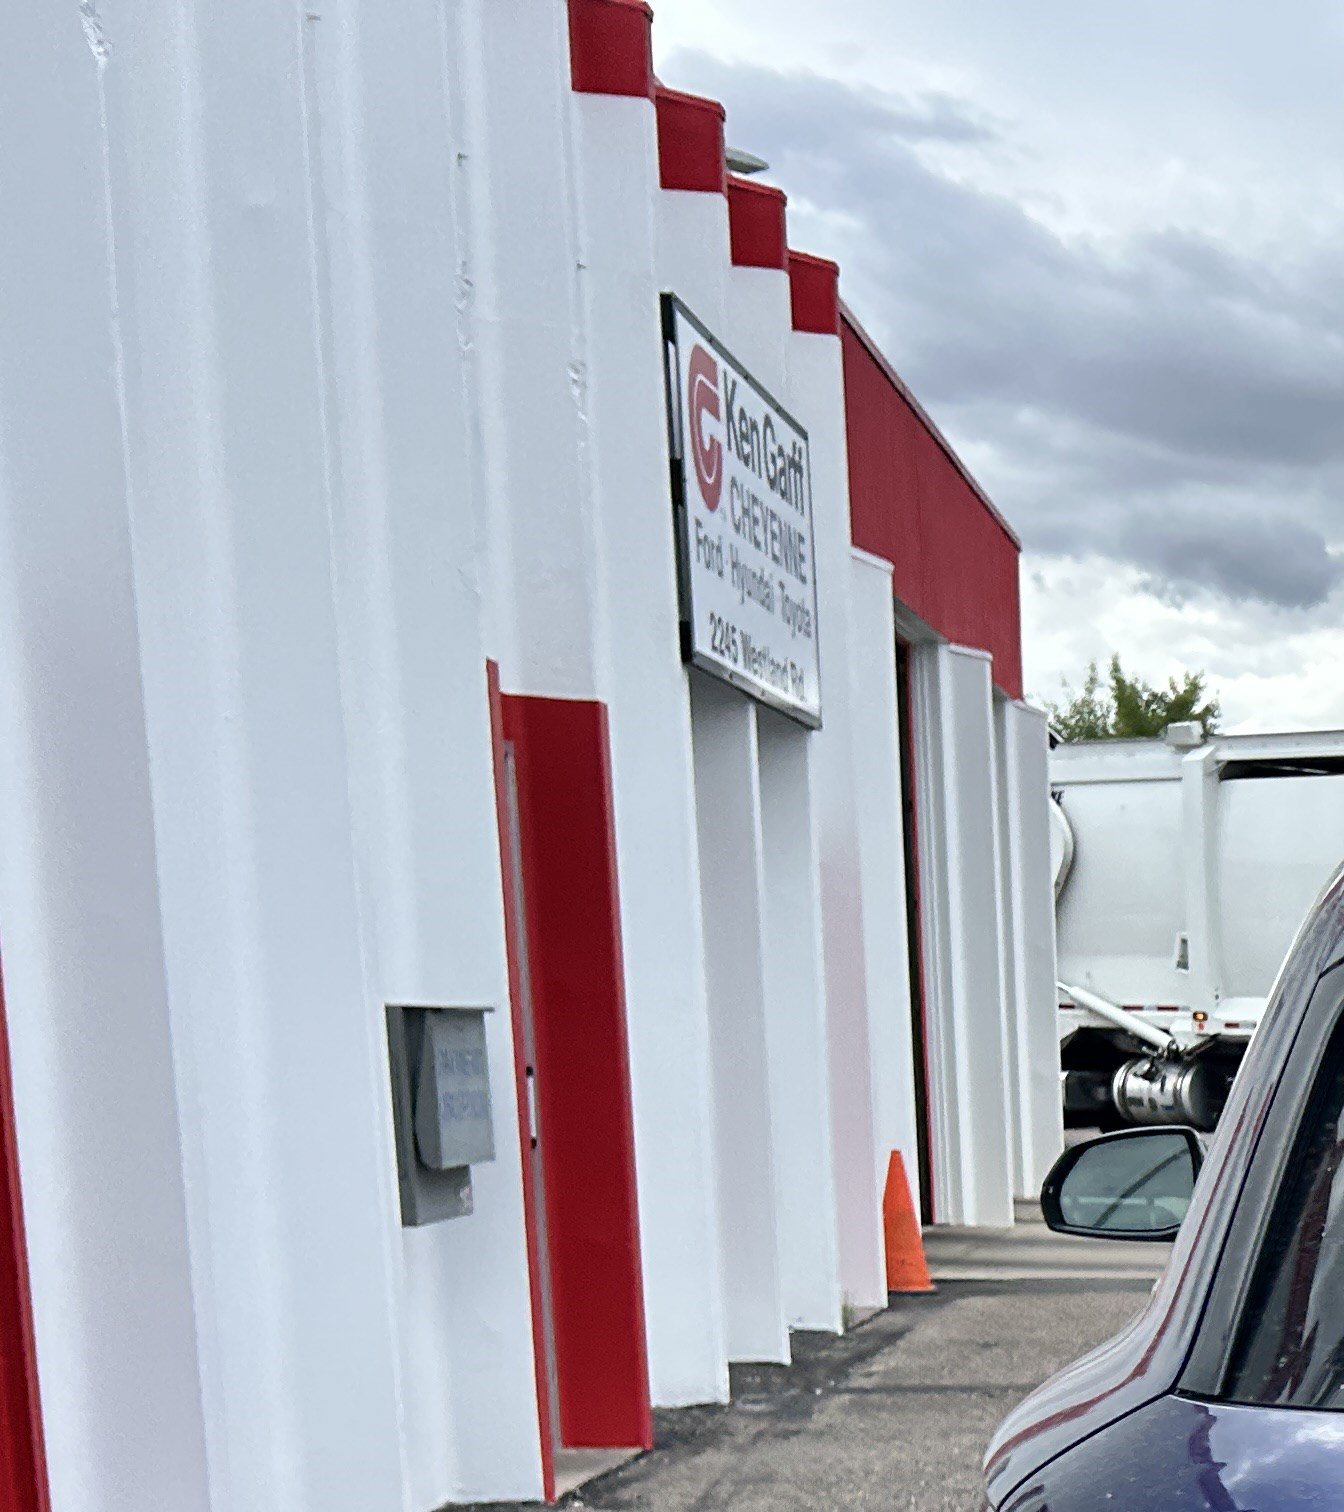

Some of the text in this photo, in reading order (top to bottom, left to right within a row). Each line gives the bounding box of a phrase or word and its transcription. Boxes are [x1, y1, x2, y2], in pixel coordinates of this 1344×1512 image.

[723, 369, 805, 516] Ken Garff
[694, 517, 812, 638] Ford Hyundai Toyota
[730, 477, 807, 584] CHEYENNE
[709, 611, 739, 664] 2245
